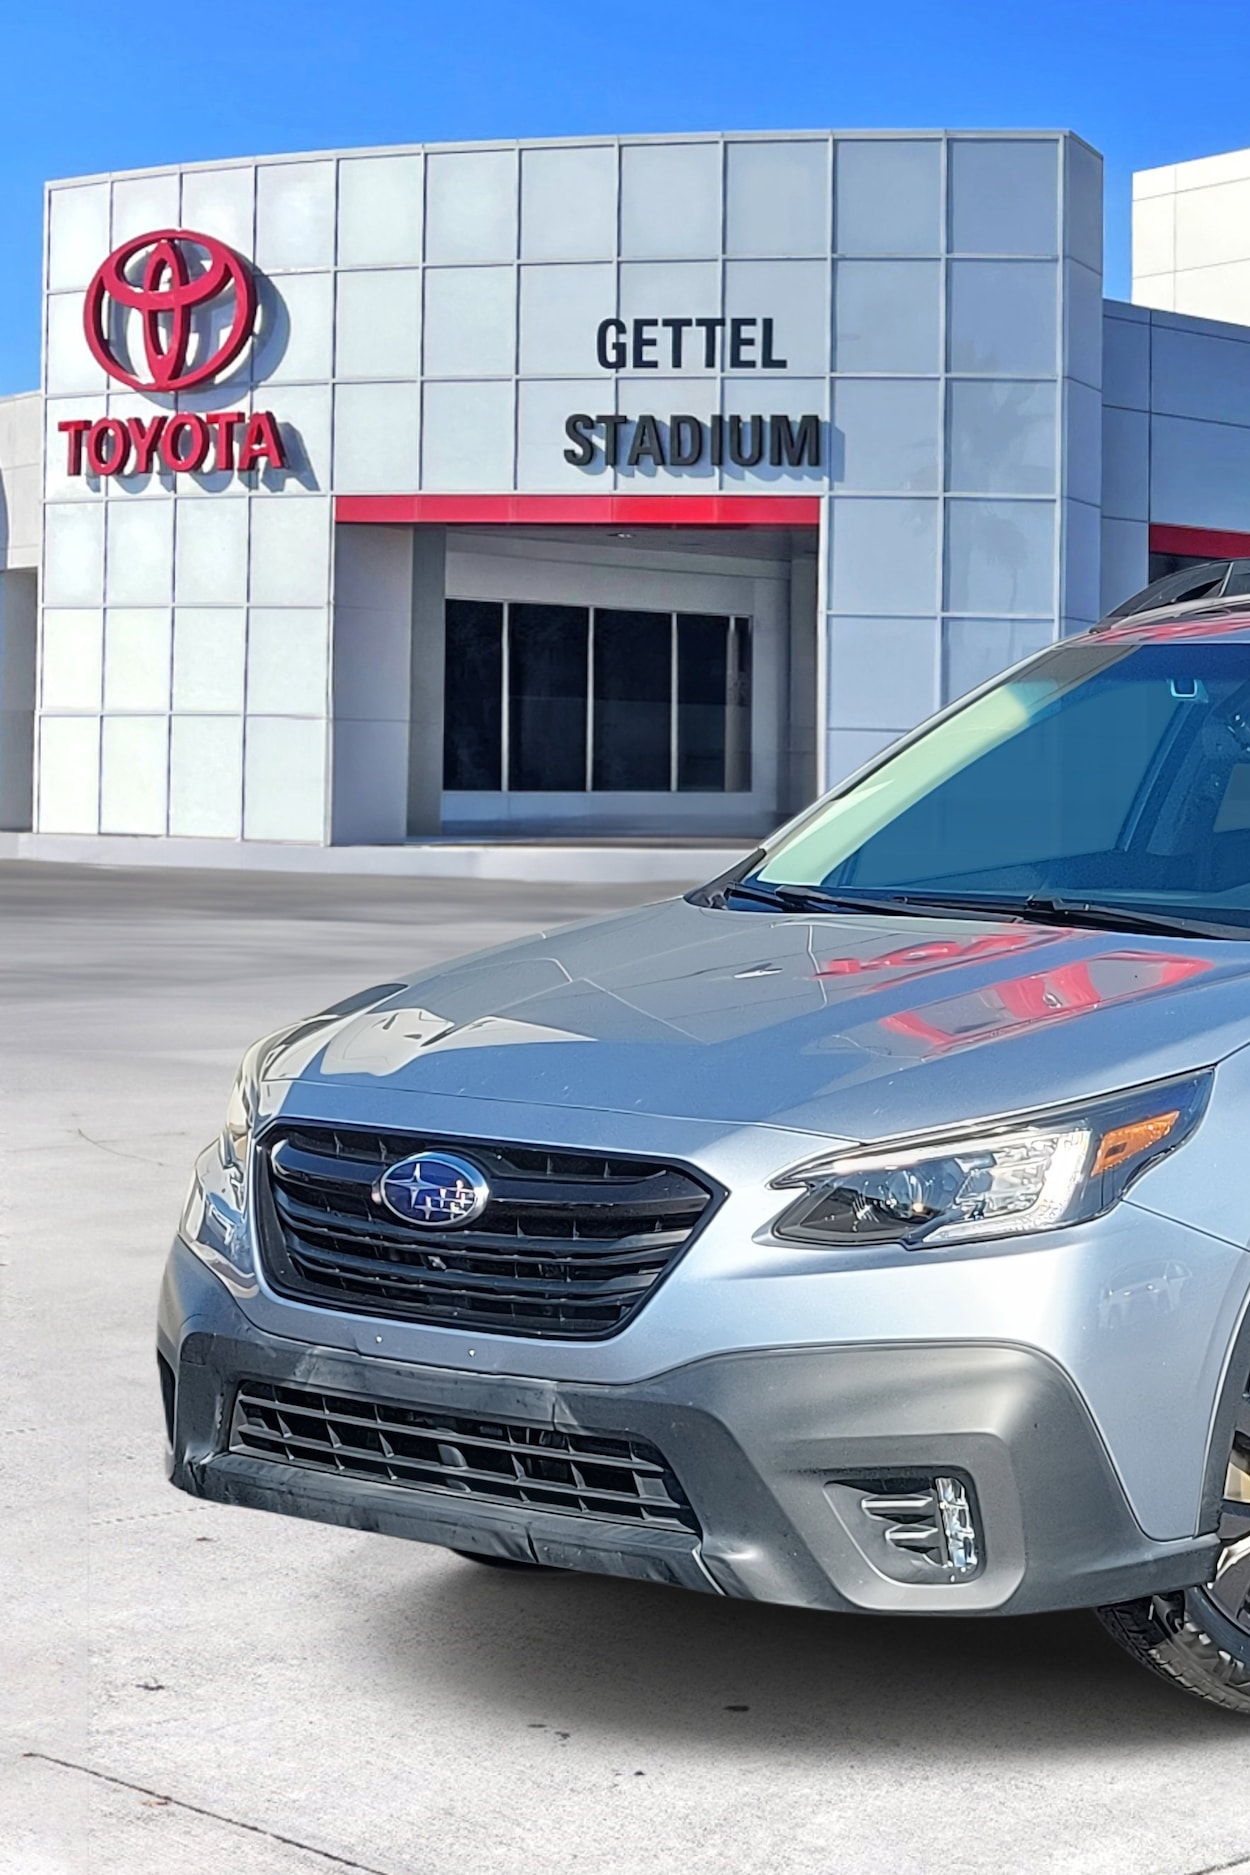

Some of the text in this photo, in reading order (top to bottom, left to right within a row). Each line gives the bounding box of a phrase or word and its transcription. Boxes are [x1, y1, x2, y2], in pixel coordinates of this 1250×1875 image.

[596, 317, 788, 369] GETTEL
[57, 410, 289, 476] TOYOTA
[563, 413, 820, 467] STADIUM
